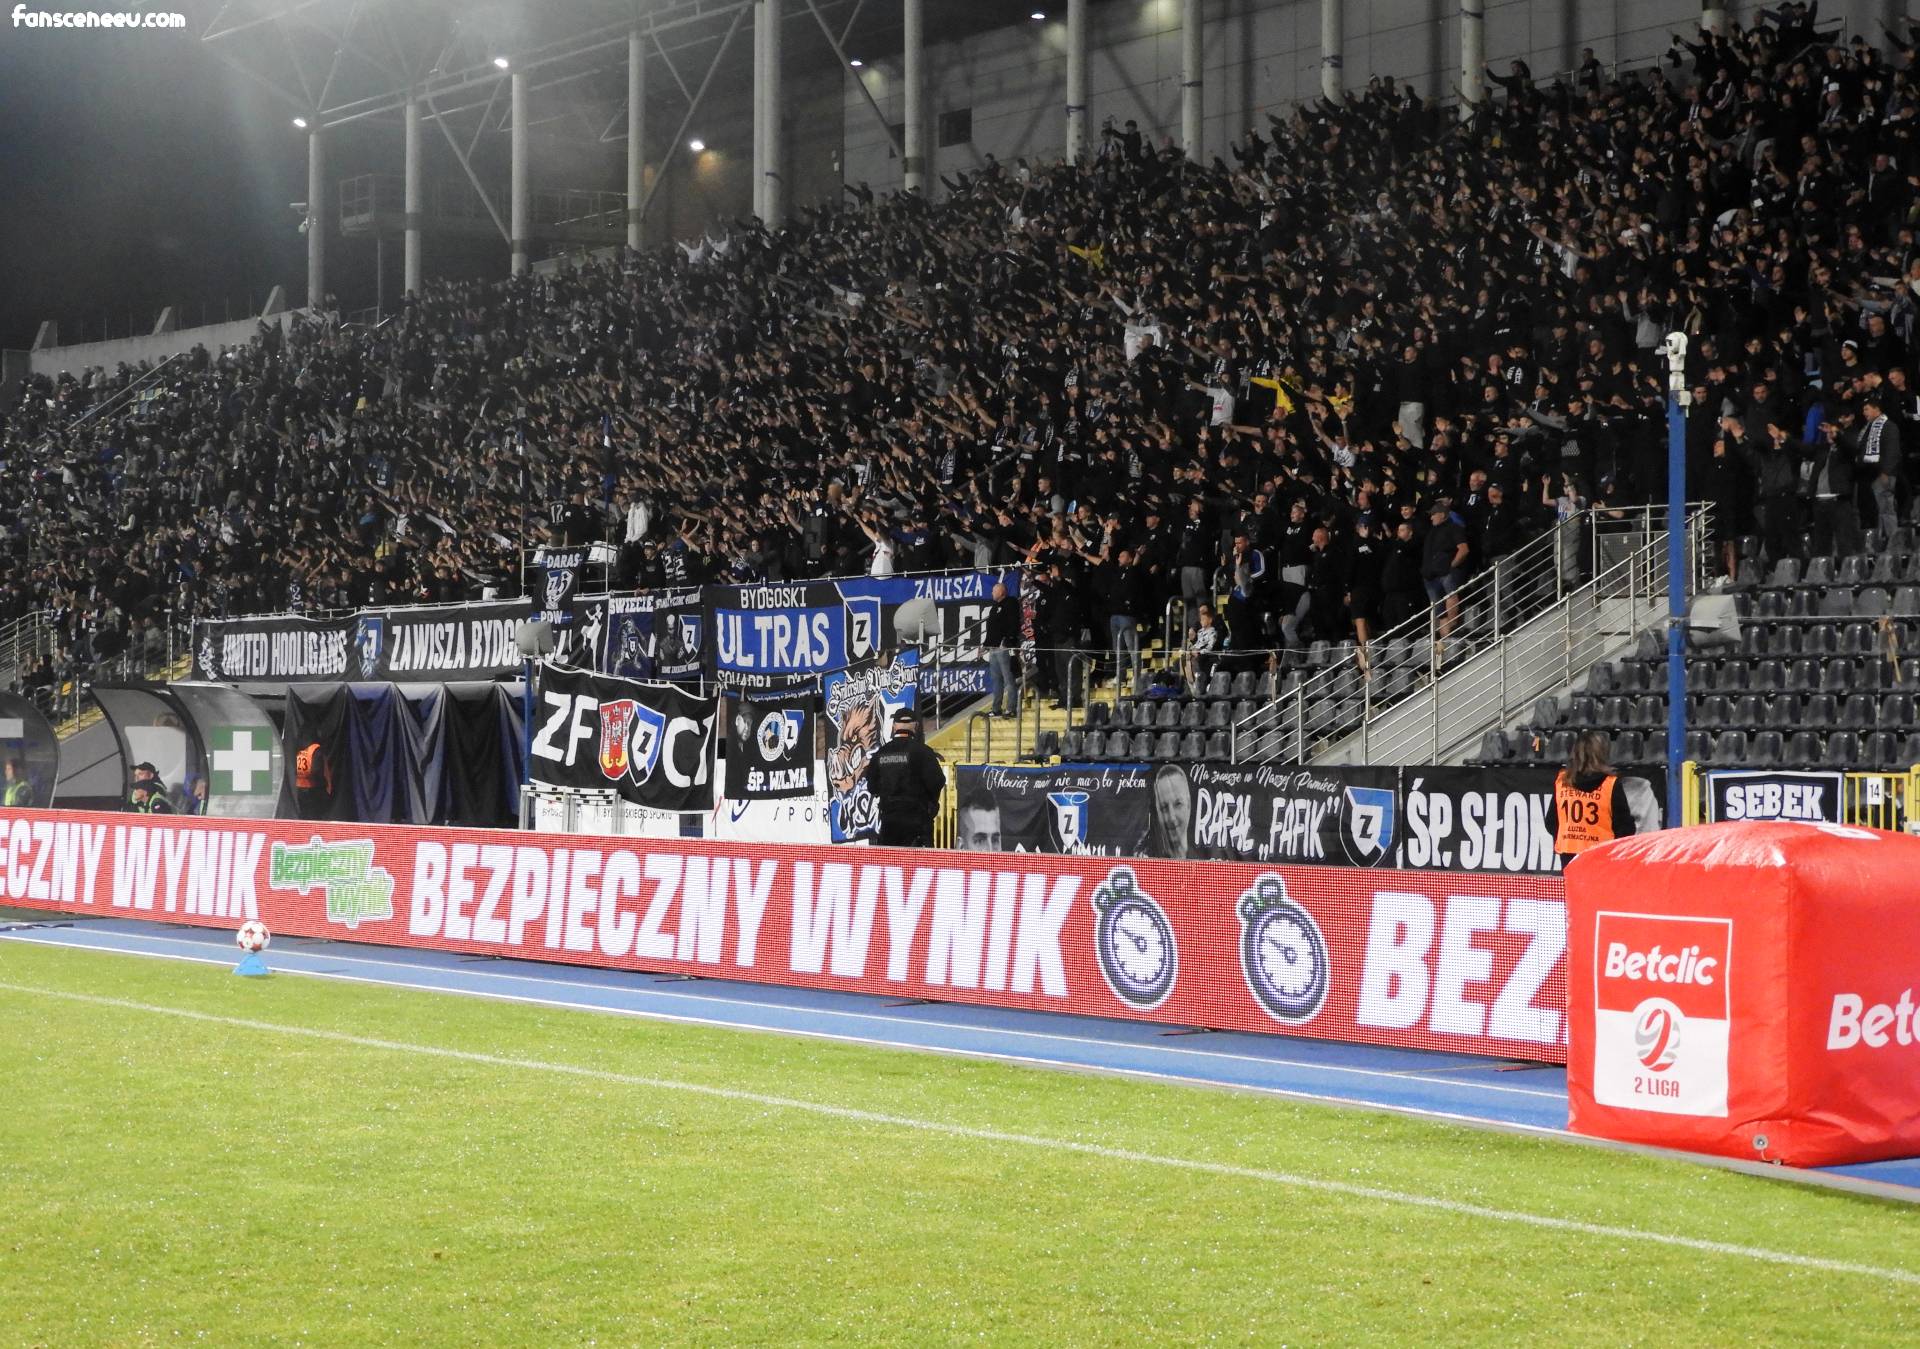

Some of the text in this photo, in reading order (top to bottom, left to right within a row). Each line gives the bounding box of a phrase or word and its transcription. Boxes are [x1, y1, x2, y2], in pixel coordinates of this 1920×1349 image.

[546, 553, 580, 568] DARAS
[741, 586, 807, 609] BYDGOSKI
[914, 575, 983, 600] ZAWISZA
[221, 629, 348, 676] UNITED HOOLIGANS
[389, 621, 465, 670] ZAWISZA
[716, 612, 830, 669] ULTRAS
[531, 691, 598, 767] ZF
[770, 768, 807, 792] WILMA
[1102, 768, 1113, 788] to
[1115, 768, 1147, 794] jestem
[1190, 763, 1209, 785] Na
[1869, 784, 1880, 799] 14
[1560, 789, 1601, 801] STEWARD
[1561, 800, 1600, 826] 103
[1726, 783, 1825, 820] SEBEK
[1194, 787, 1255, 852] RAFAŁ
[1460, 791, 1562, 871] SŁON
[112, 824, 267, 921] WYNIK
[408, 841, 1084, 998] BEZPIECZNY WYNIK
[1356, 891, 1569, 1045] BEZ
[1604, 941, 1718, 986] Betclic
[1634, 1076, 1680, 1098] 2 LIGA
